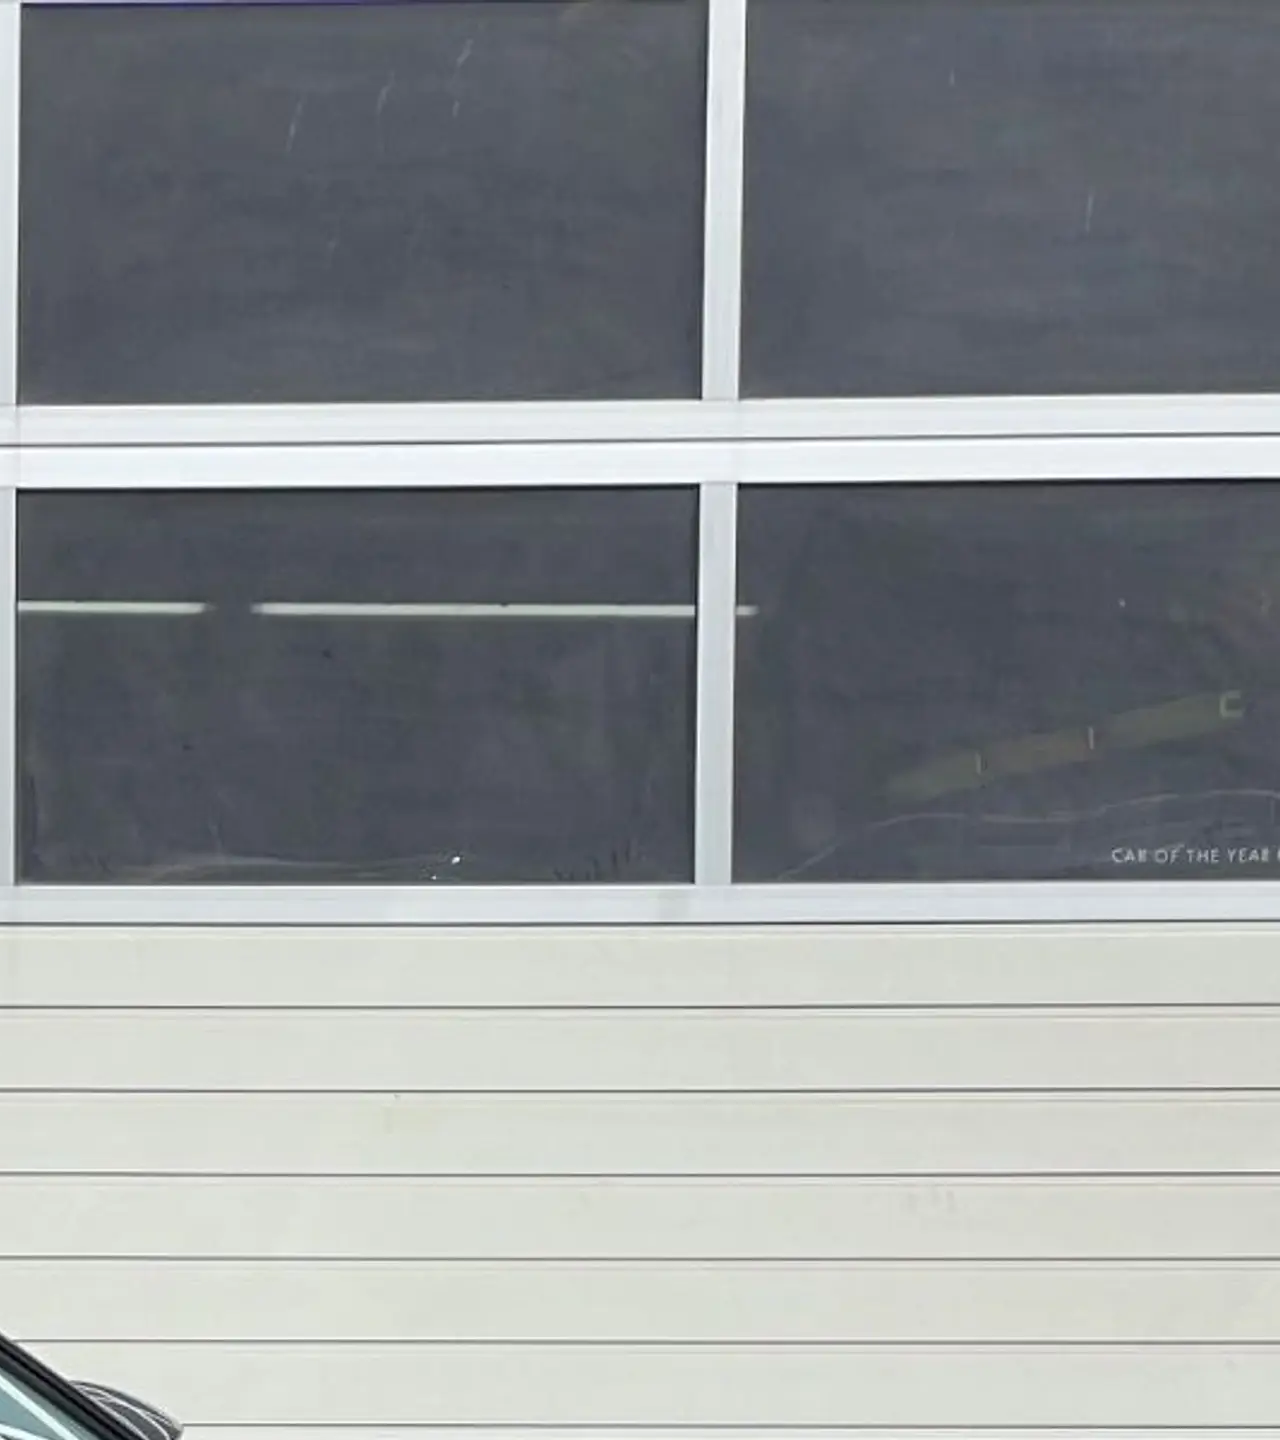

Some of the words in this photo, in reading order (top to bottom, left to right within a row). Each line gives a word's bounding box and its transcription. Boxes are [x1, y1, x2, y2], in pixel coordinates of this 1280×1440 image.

[1111, 847, 1147, 864] CAR
[1154, 847, 1179, 864] OF
[1186, 847, 1220, 864] THE
[1227, 847, 1269, 864] YEAR
